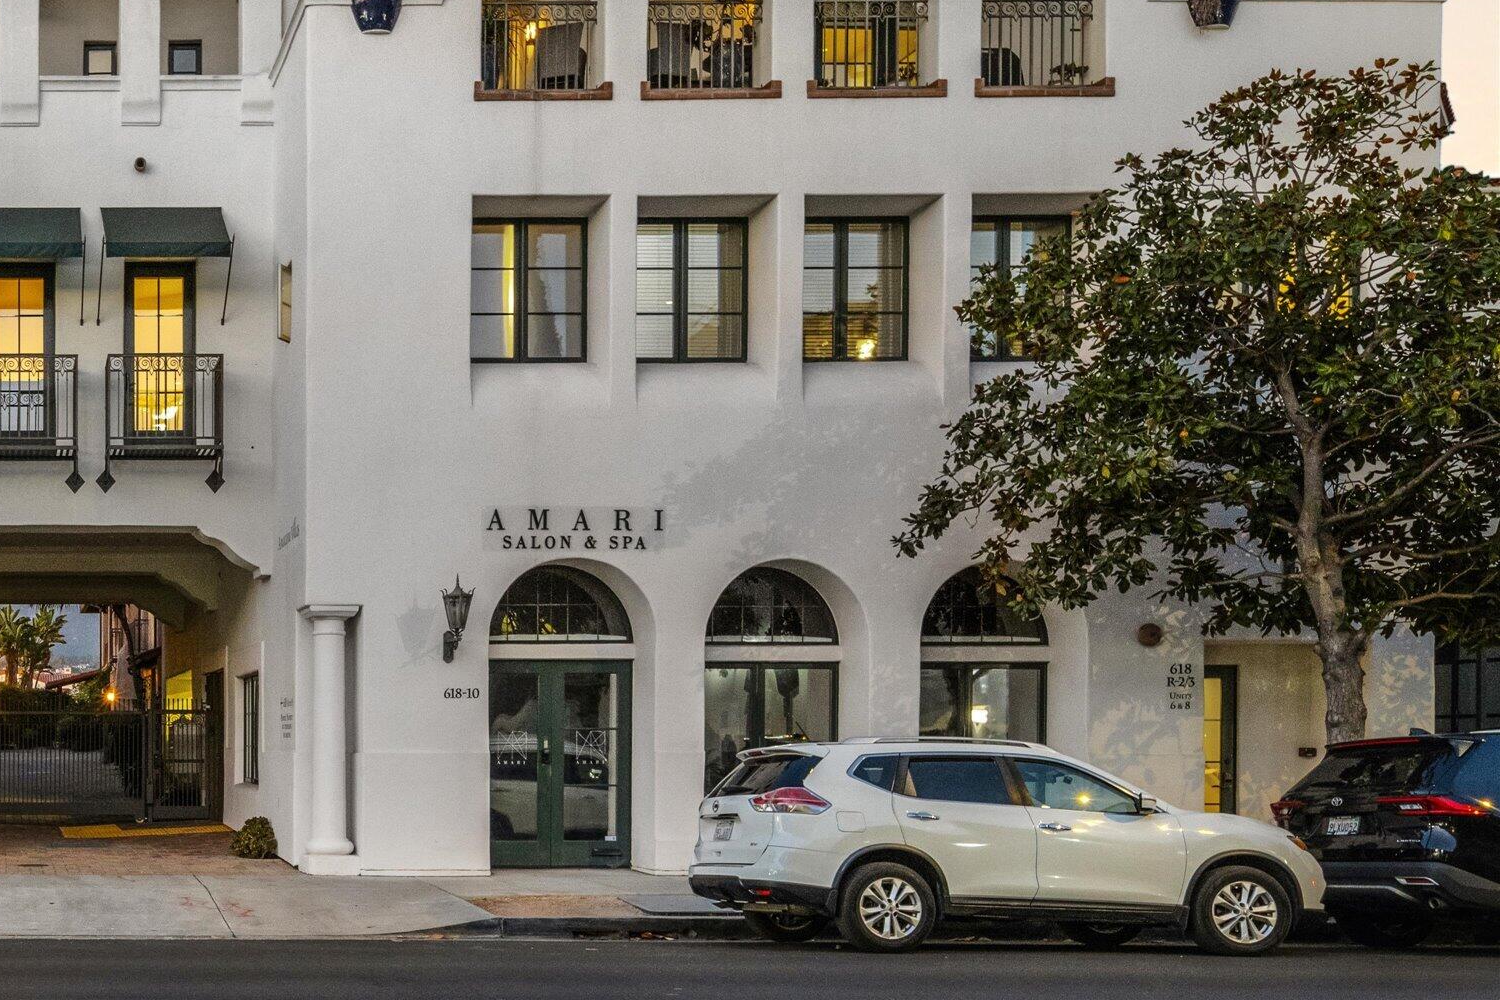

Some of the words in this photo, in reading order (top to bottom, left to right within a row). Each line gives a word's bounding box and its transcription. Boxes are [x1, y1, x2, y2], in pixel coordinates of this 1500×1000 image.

[486, 508, 664, 531] AMARI
[502, 535, 572, 549] SALON
[584, 535, 598, 549] &
[609, 535, 647, 550] SPA
[1170, 663, 1192, 674] 618
[1166, 676, 1195, 688] R-2/3
[443, 688, 480, 699] 618-10
[1170, 701, 1176, 710] 6
[1184, 701, 1191, 710] 8
